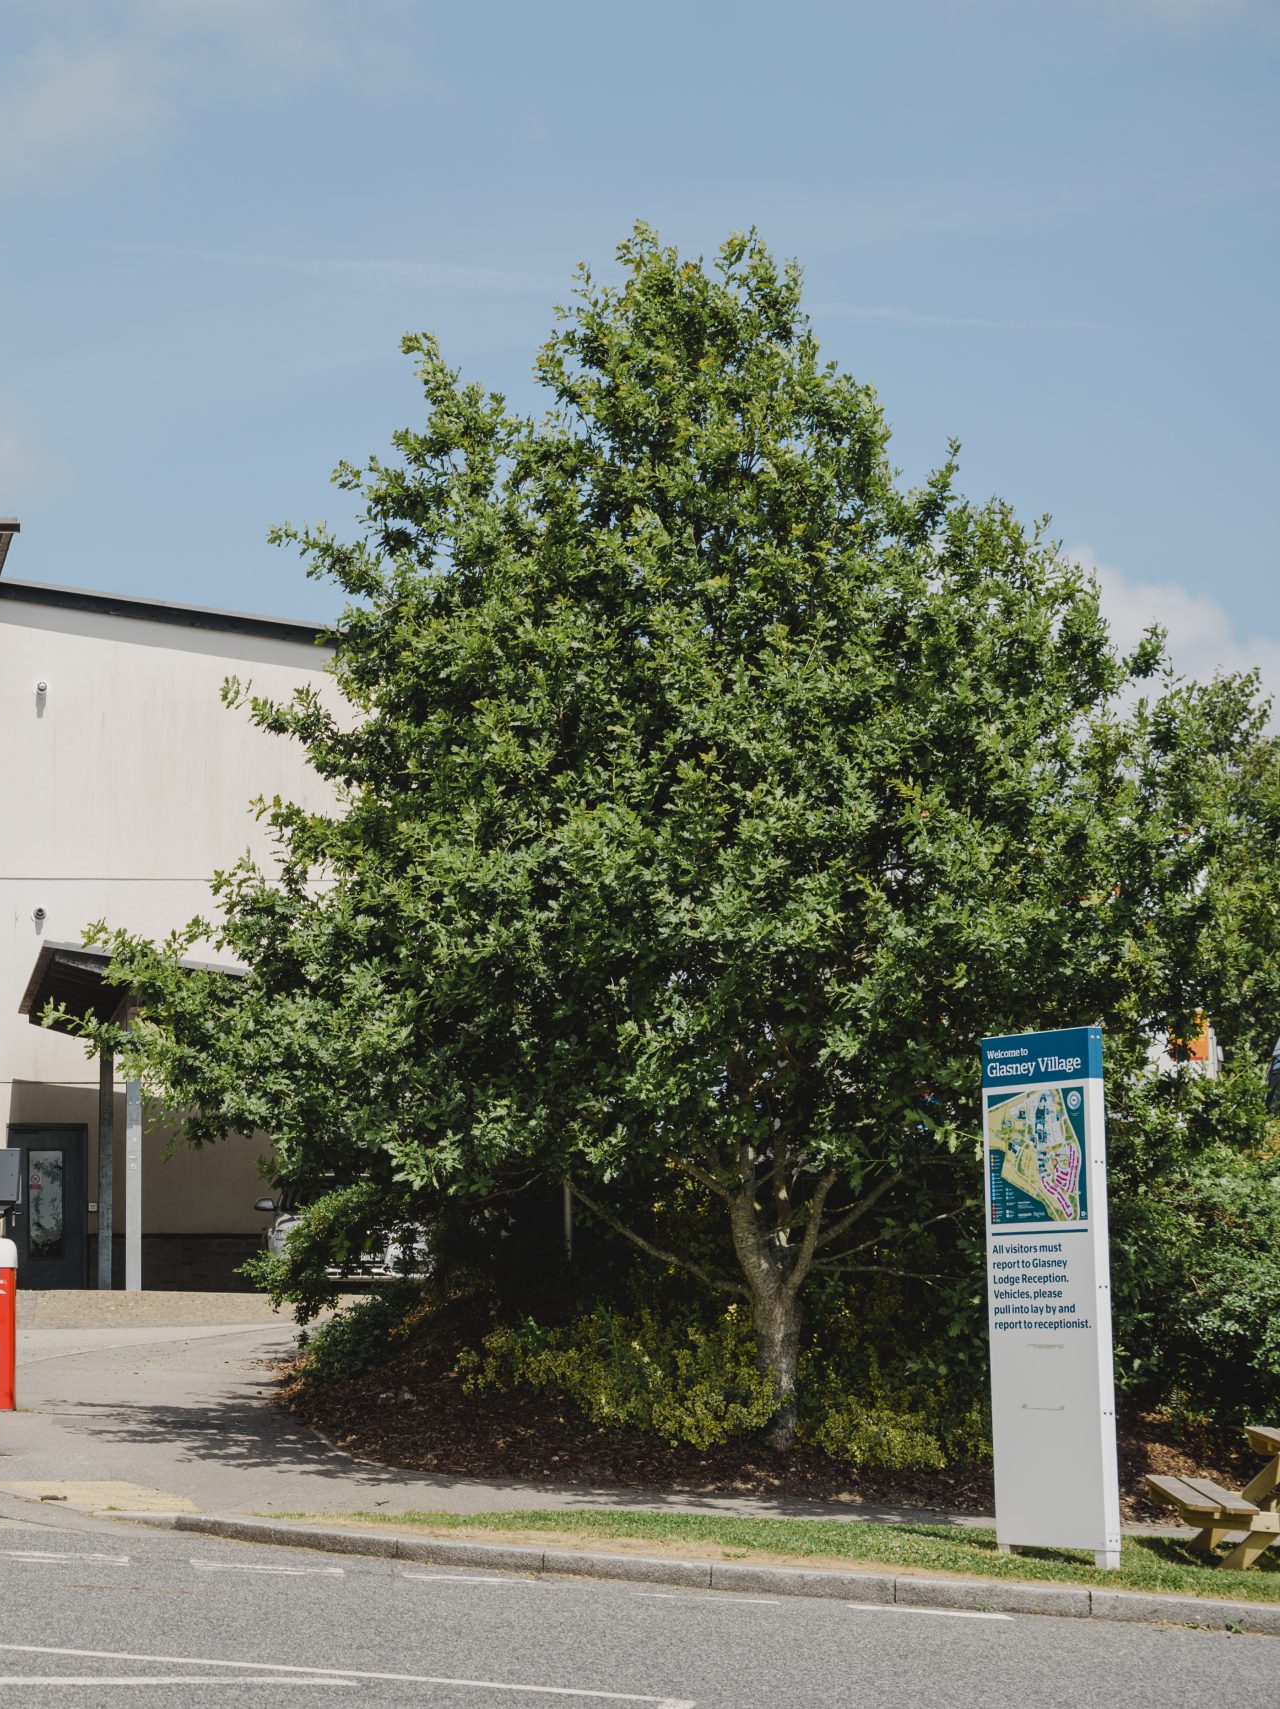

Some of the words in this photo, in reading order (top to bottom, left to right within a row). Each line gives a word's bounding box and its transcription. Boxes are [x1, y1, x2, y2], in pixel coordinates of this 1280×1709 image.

[986, 1049, 1020, 1059] Welcome
[1020, 1047, 1029, 1056] to
[987, 1061, 1036, 1078] Glasney
[1037, 1056, 1081, 1073] Village
[992, 1244, 1004, 1254] All
[1005, 1243, 1038, 1254] visitors
[1039, 1243, 1062, 1253] must
[992, 1260, 1020, 1271] report
[1021, 1259, 1031, 1269] to
[1032, 1258, 1068, 1269] Glasney
[993, 1274, 1020, 1286] Lodge
[1021, 1273, 1069, 1285] Reception.
[993, 1289, 1032, 1300] Vehicles,
[1033, 1289, 1063, 1300] please
[994, 1304, 1011, 1316] pull
[1012, 1304, 1030, 1314] into
[1031, 1304, 1044, 1315] lay
[1045, 1303, 1057, 1315] by
[1058, 1303, 1076, 1314] and
[994, 1319, 1022, 1331] report
[1023, 1319, 1033, 1329] to
[1034, 1318, 1092, 1331] receptionist.
